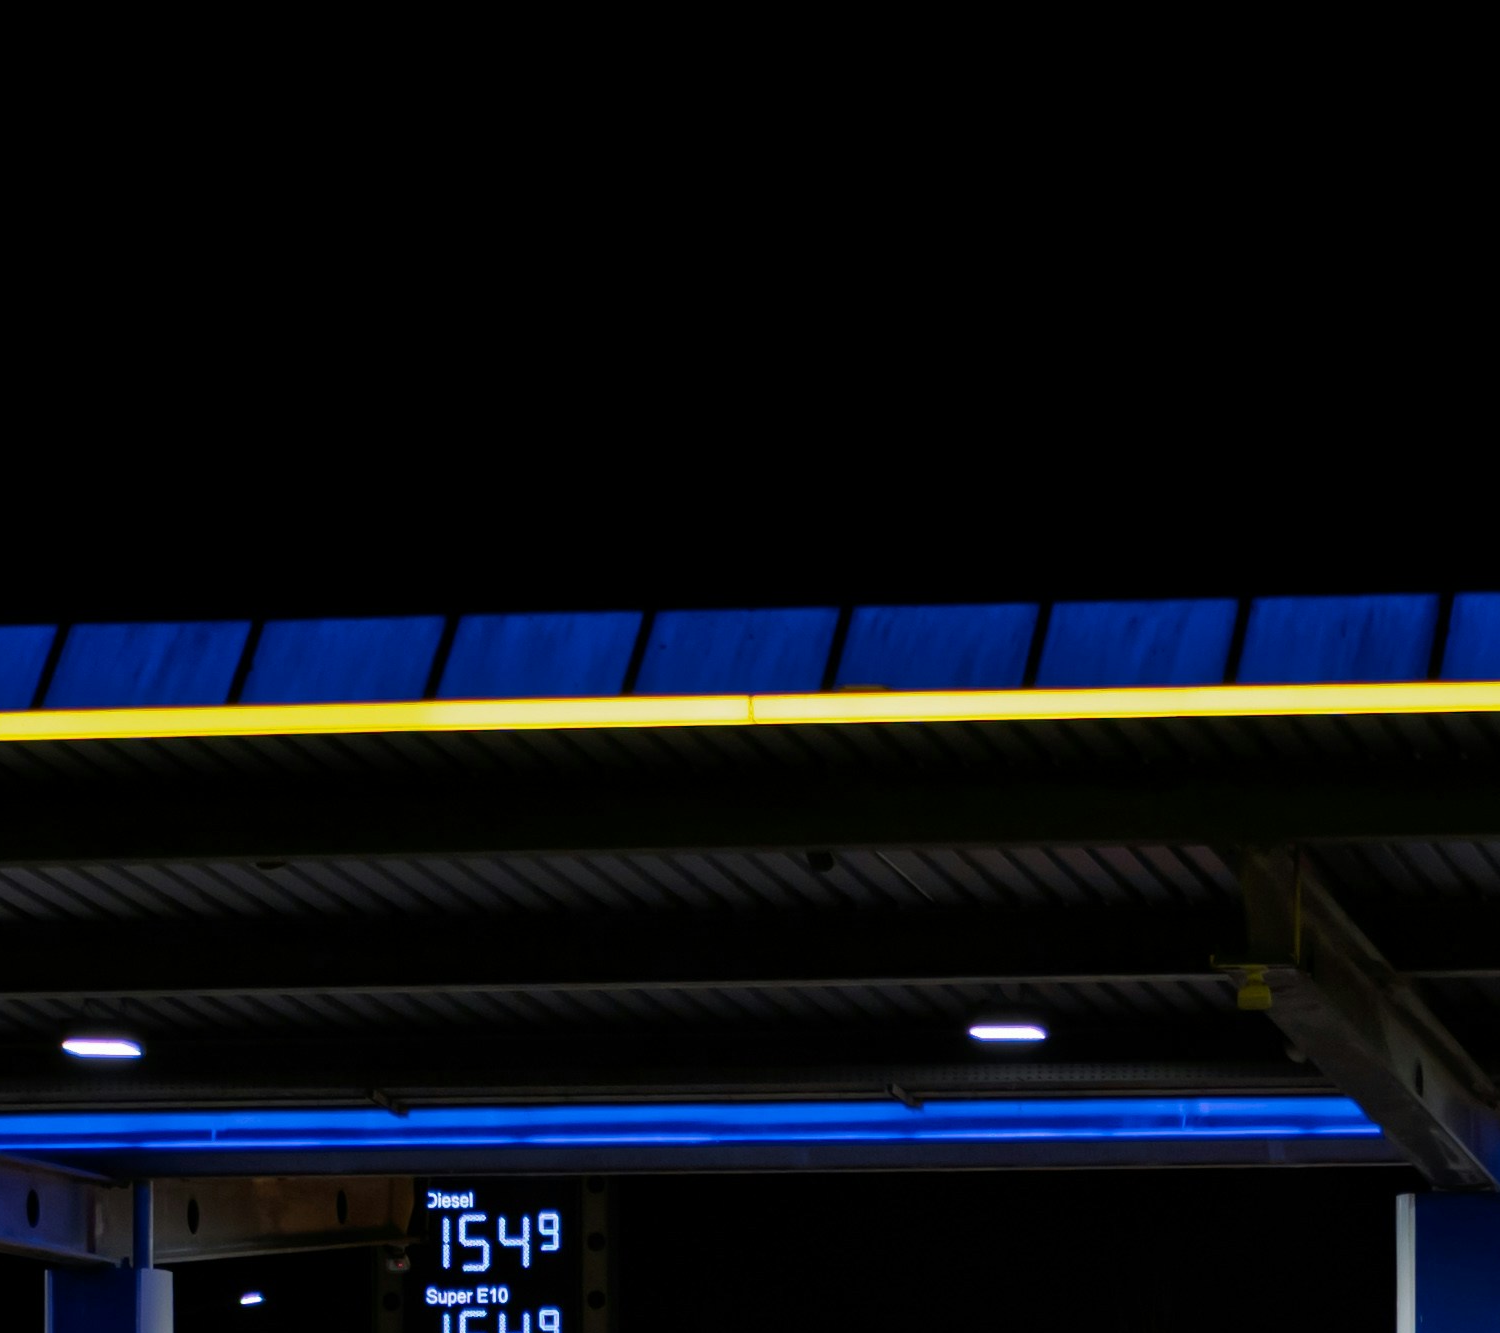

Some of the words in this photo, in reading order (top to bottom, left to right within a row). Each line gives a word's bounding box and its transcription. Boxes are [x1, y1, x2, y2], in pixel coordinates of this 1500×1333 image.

[427, 1192, 474, 1209] Diesel
[426, 1288, 474, 1307] Super
[476, 1287, 509, 1304] E10
